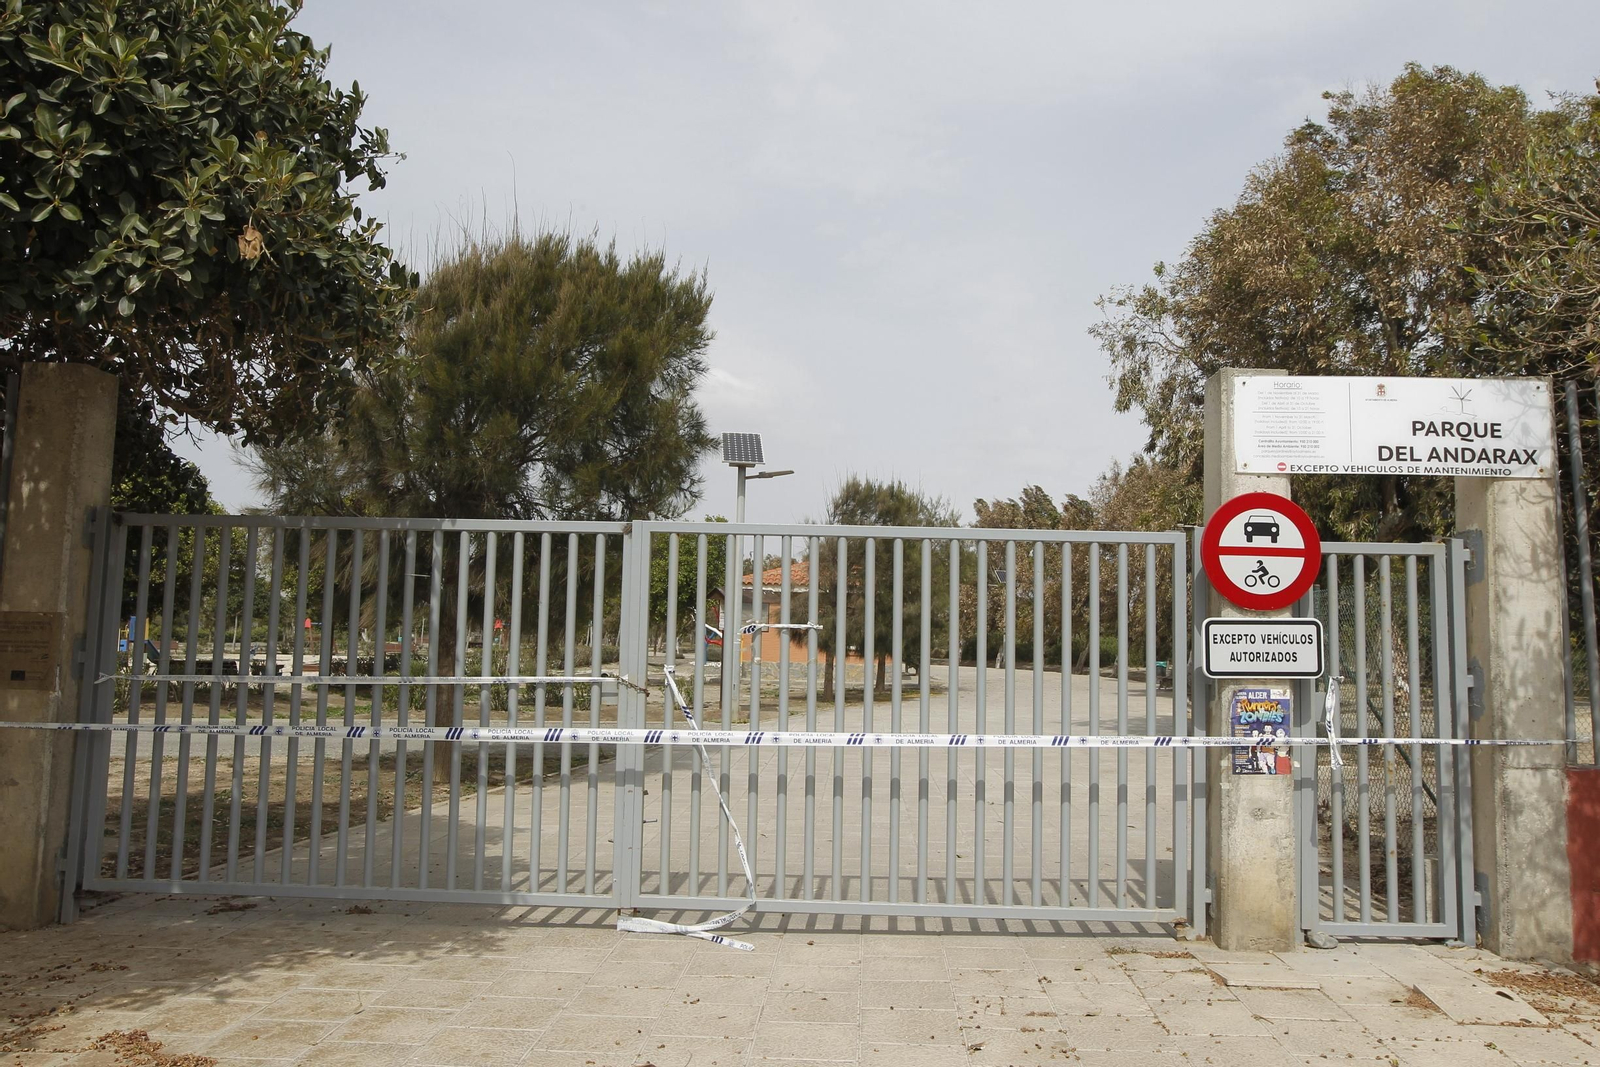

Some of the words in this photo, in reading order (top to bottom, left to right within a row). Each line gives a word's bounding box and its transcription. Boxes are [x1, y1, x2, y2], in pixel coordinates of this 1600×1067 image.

[1412, 420, 1502, 442] PARQUE
[1377, 445, 1422, 462] DEL
[1427, 446, 1538, 465] ANDARAX
[1290, 464, 1339, 472] EXCEPTO
[1342, 465, 1404, 473] VEHICULOS
[1423, 466, 1512, 476] MANTENIMIENTO
[1213, 634, 1256, 645] EXCEPTO
[1261, 631, 1314, 645] VEHÍCULOS
[1230, 651, 1298, 663] AUTORIZADOS
